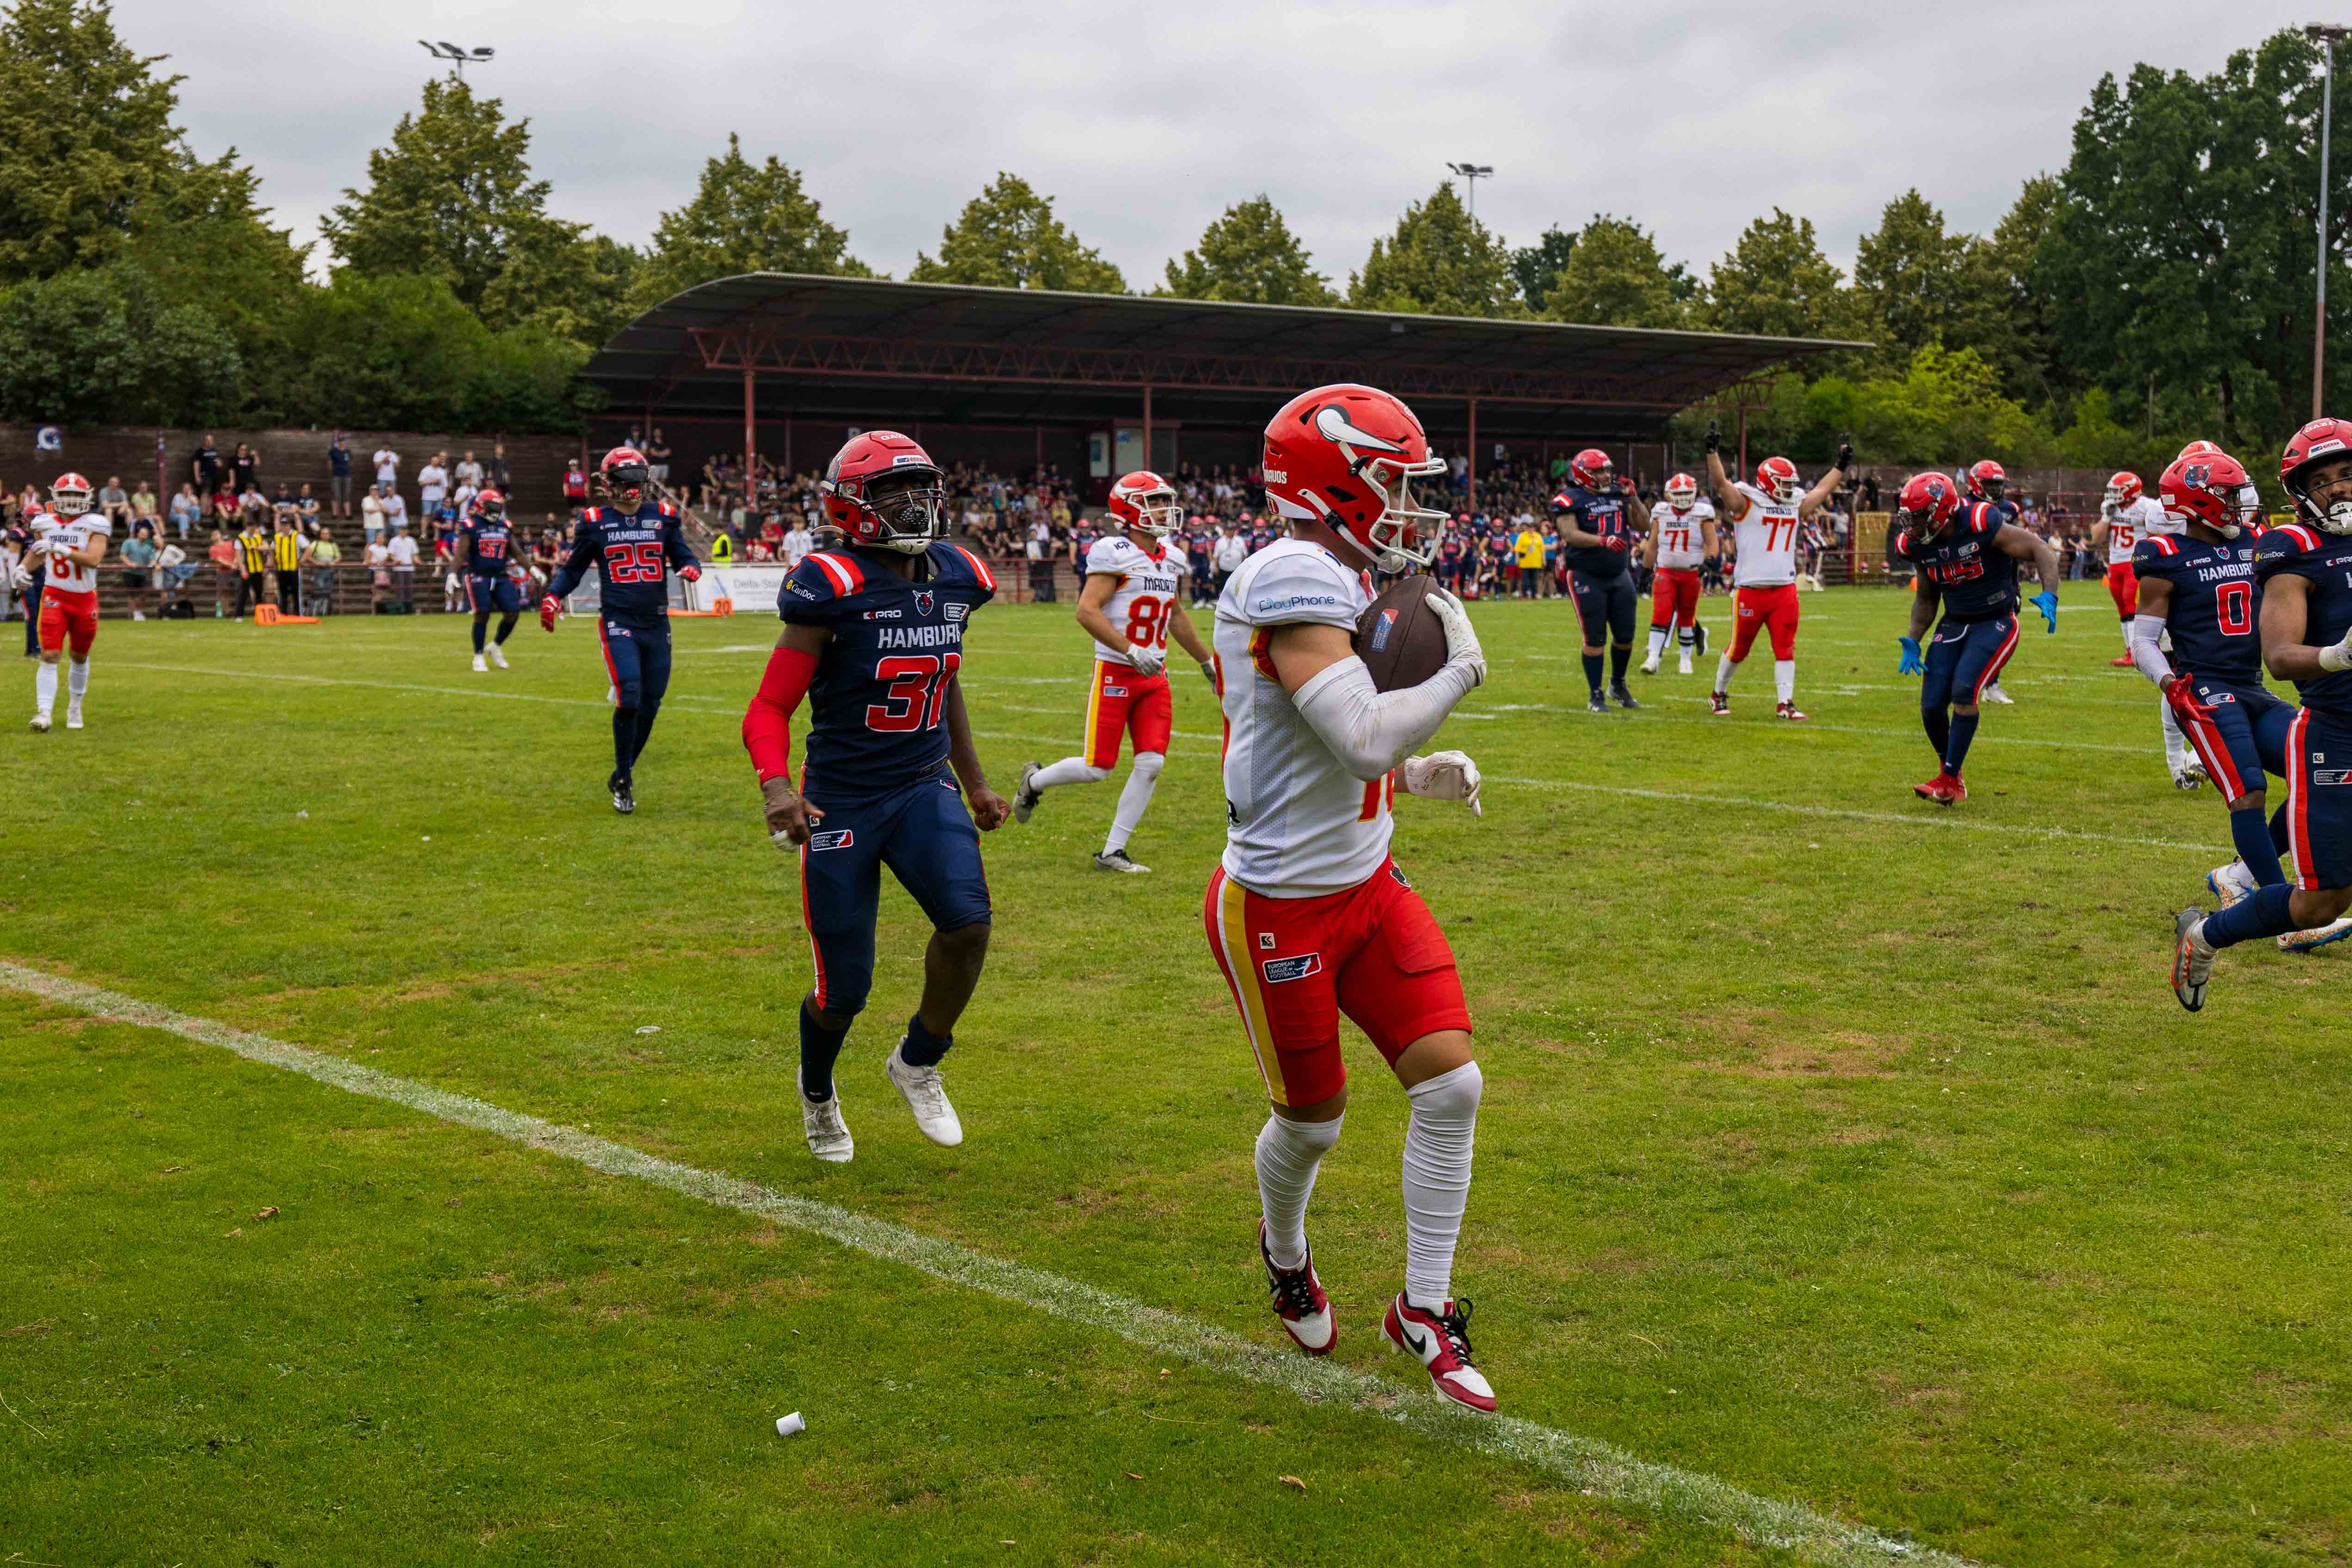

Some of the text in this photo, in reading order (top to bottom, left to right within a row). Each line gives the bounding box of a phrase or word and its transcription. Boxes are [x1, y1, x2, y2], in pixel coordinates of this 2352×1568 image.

[607, 530, 655, 542] HAMBURG
[1664, 528, 1690, 552] 71
[1762, 515, 1797, 552] 77
[2109, 525, 2134, 549] 75
[604, 541, 663, 583] 25
[2199, 563, 2254, 582] HAMBUR
[791, 584, 815, 600] CanDoc
[2216, 581, 2252, 636] 0
[865, 652, 962, 732] 31
[1268, 961, 1295, 969] EUROPEAN
